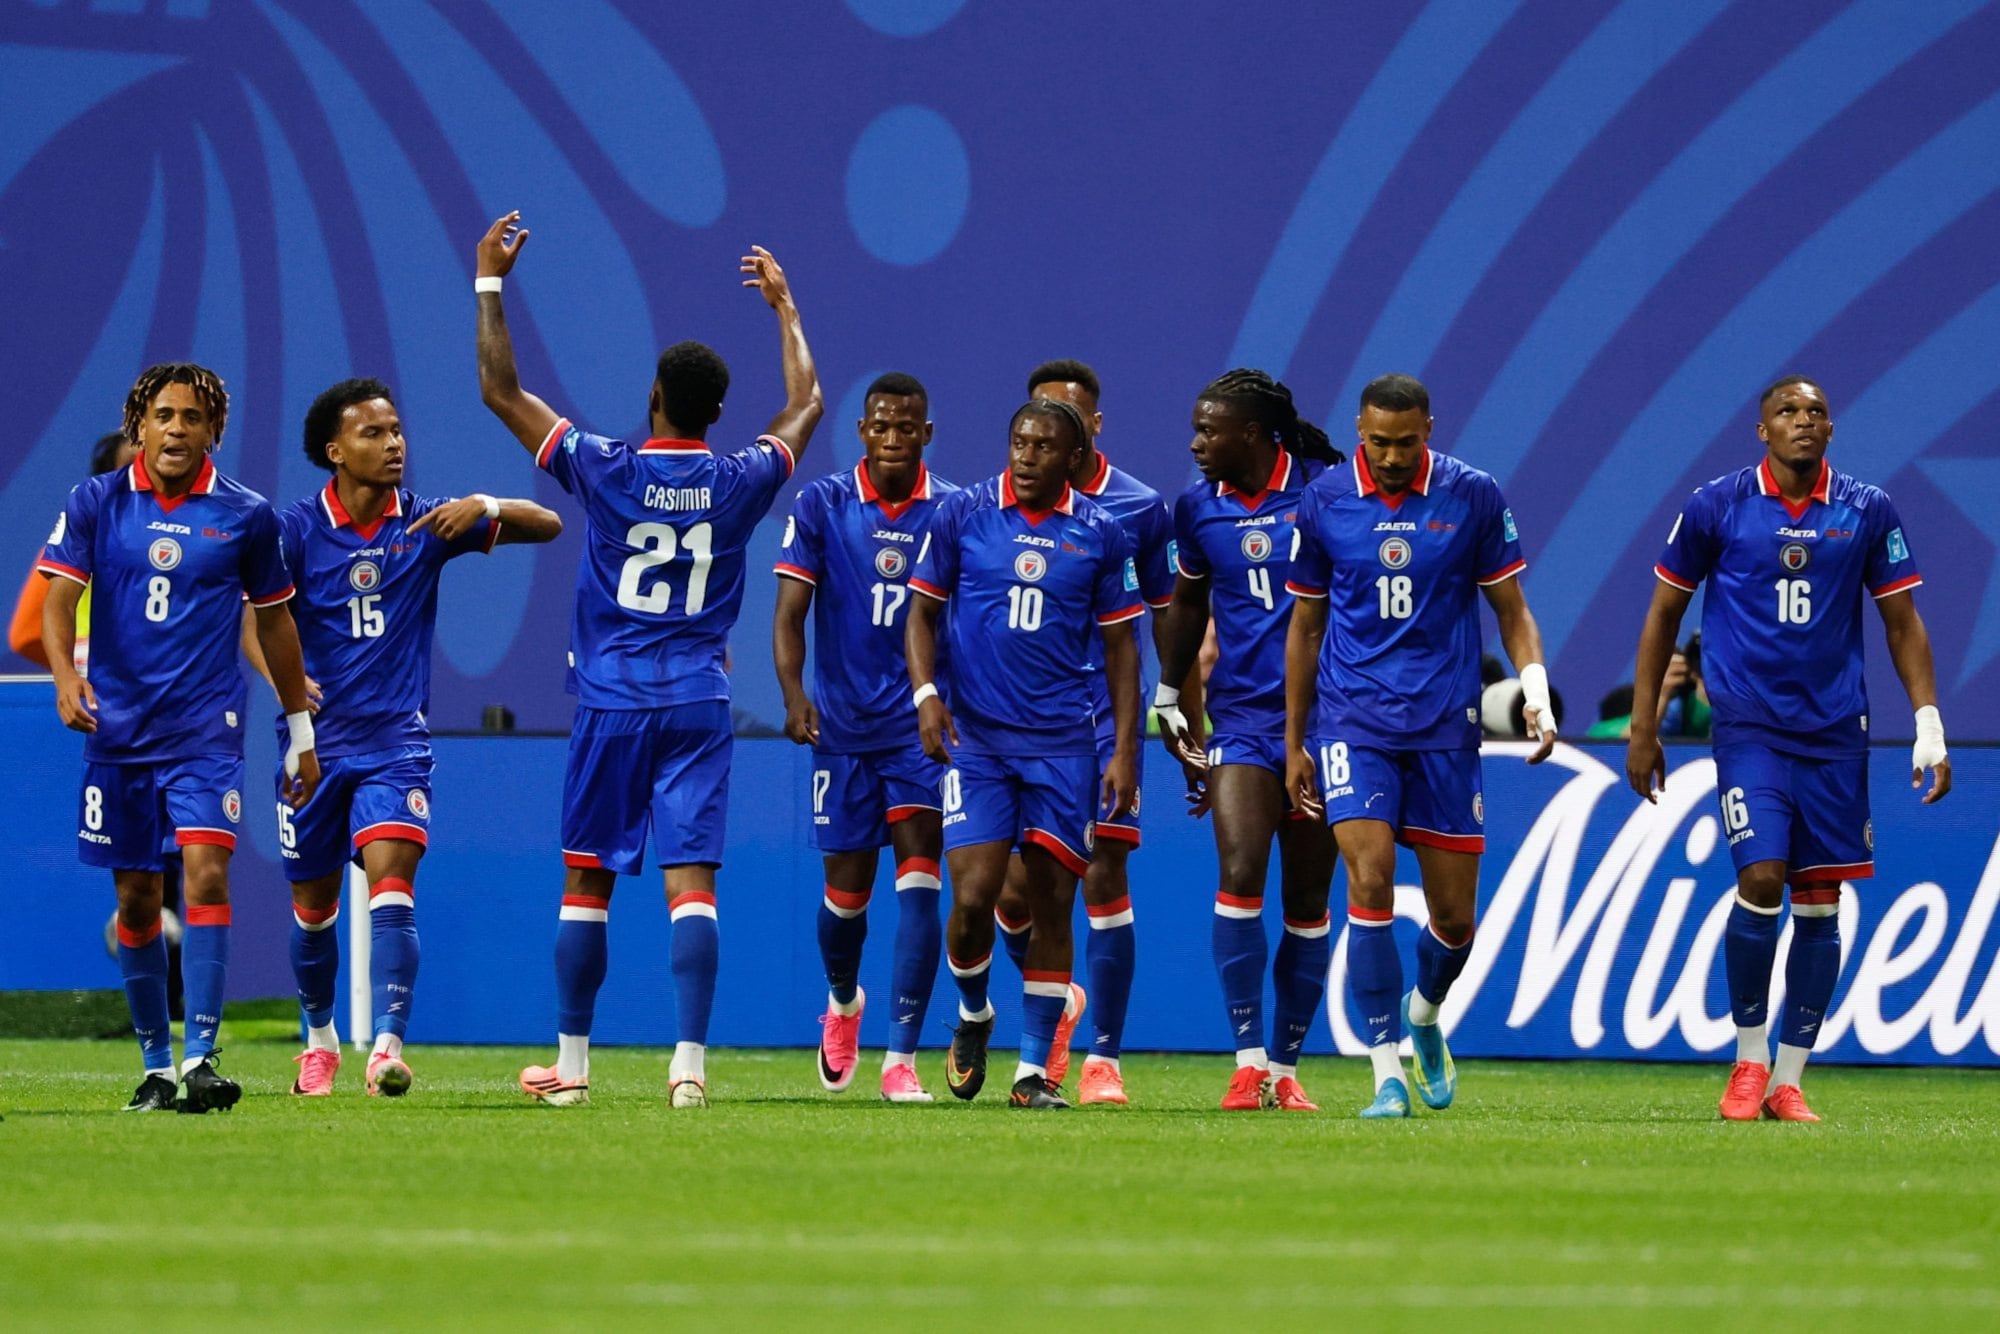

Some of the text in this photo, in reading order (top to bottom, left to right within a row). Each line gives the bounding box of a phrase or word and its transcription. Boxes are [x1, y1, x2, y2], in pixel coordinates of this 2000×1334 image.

[643, 484, 712, 511] CASIMIR
[146, 521, 191, 536] SAETA
[871, 529, 914, 544] SAETA
[1012, 533, 1056, 549] SAETA
[1235, 515, 1276, 528] SAETA
[1372, 521, 1417, 532] SAETA
[1775, 527, 1817, 539] SAETA
[617, 521, 713, 617] 21
[1247, 567, 1274, 610] 4
[145, 575, 172, 623] 8
[346, 593, 386, 639] 15
[871, 582, 906, 628] 17
[1007, 584, 1044, 632] 10
[1374, 575, 1413, 620] 18
[1774, 578, 1811, 625] 16
[1320, 740, 1351, 790] 18
[85, 785, 103, 831] 8
[1325, 785, 1355, 803] AETA
[1720, 786, 1749, 836] 16
[78, 829, 112, 846] SAETA
[276, 801, 297, 849] 15
[195, 1014, 218, 1025] FHF
[1368, 1014, 1391, 1026] FHF
